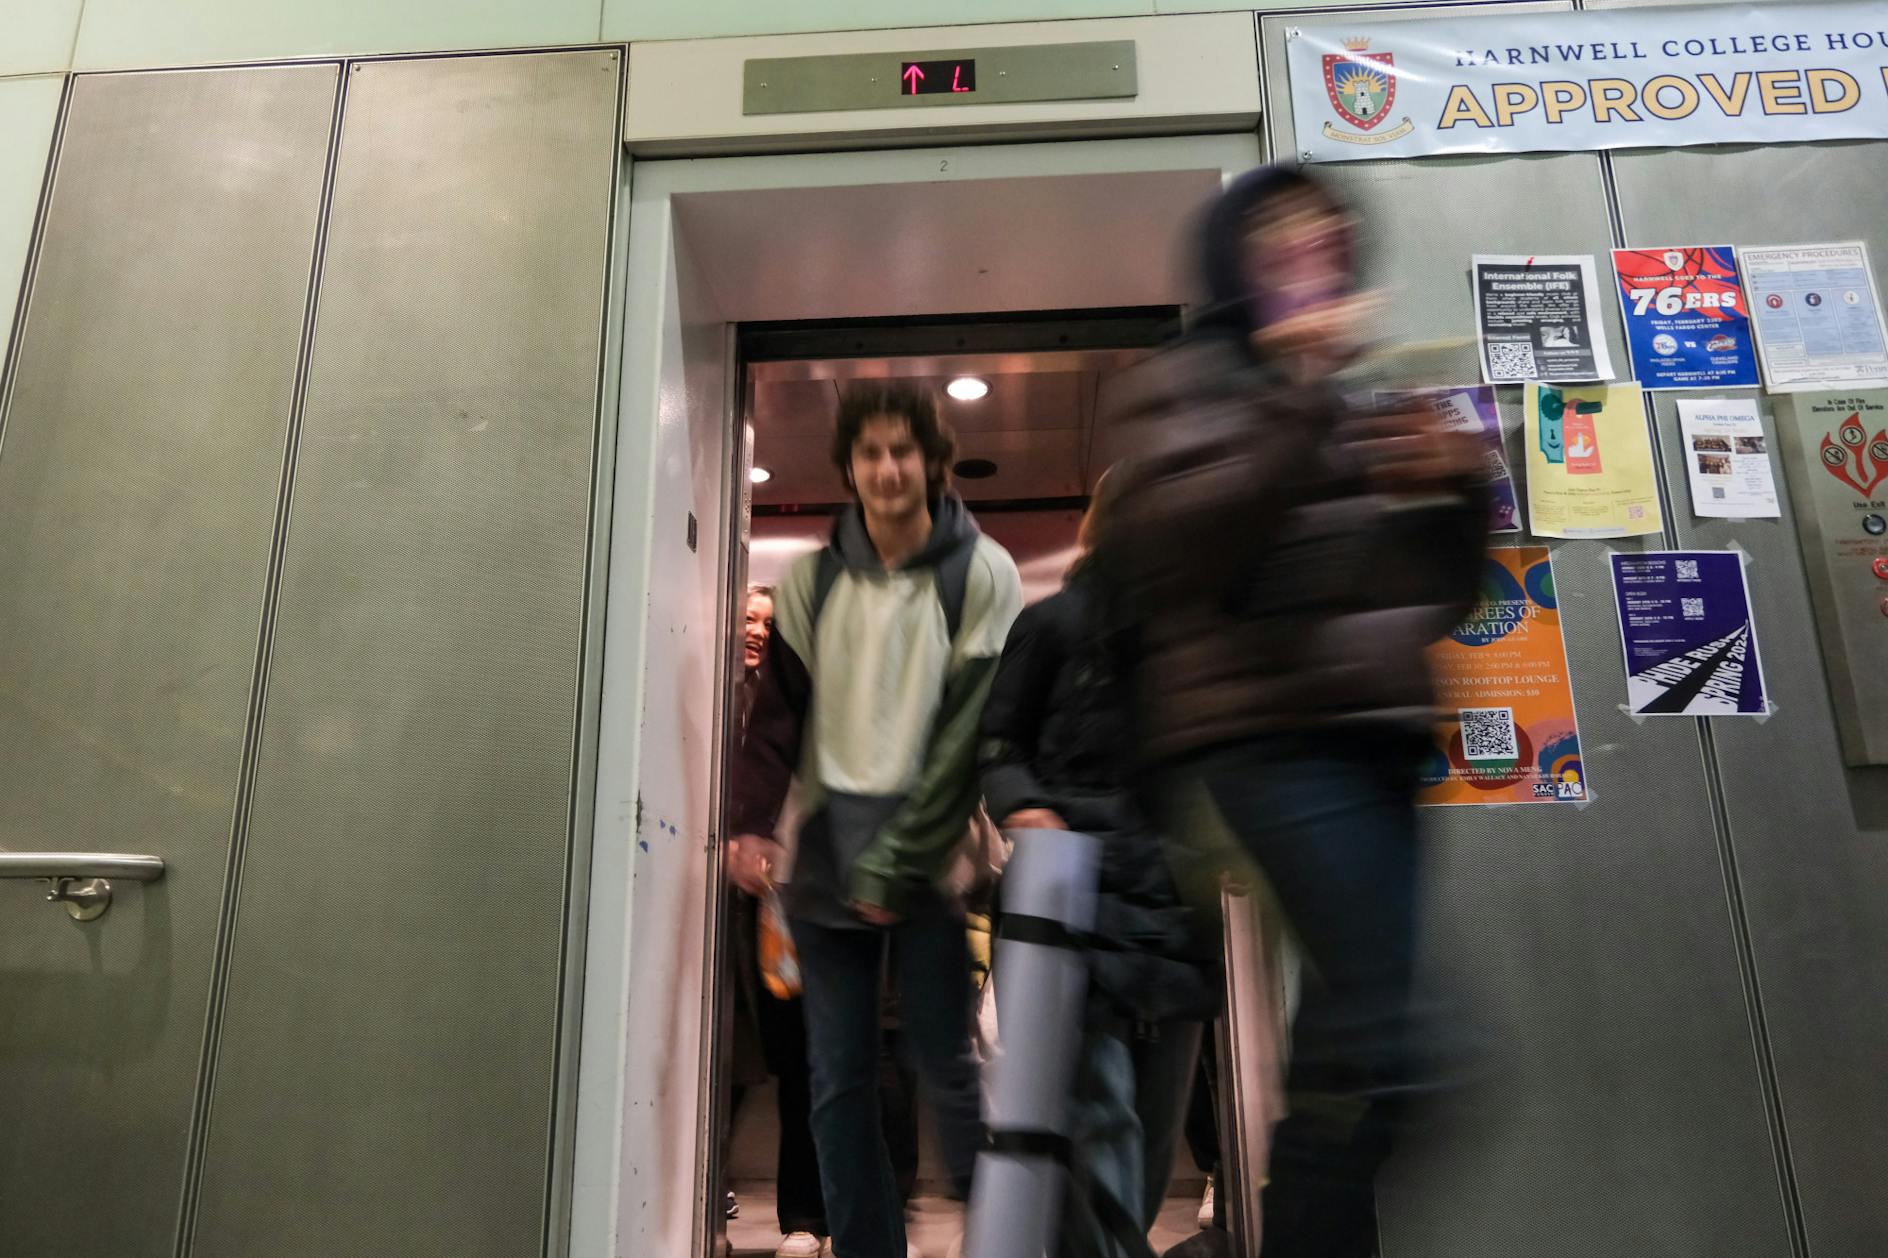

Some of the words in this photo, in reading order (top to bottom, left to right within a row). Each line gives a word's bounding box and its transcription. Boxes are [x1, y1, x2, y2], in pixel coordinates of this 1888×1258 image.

[1455, 42, 1647, 67] HARNWELL
[1661, 34, 1811, 57] COLLEGE
[1437, 68, 1861, 130] APPROVED
[939, 159, 949, 172] 2
[1747, 252, 1800, 261] EMERGENCY
[1802, 248, 1859, 258] PROCEDURES
[1483, 272, 1551, 281] International
[1552, 272, 1578, 280] Folk
[1491, 282, 1544, 291] Ensemble
[1545, 282, 1571, 291] (IFE)
[1629, 286, 1737, 316] 76ERS
[1518, 605, 1541, 619] OF
[1452, 621, 1529, 636] ARATION
[1685, 660, 1743, 711] SPRING
[1728, 624, 1748, 662] 2024
[1462, 675, 1513, 686] ROOFTOP
[1514, 673, 1560, 684] LOUNGE
[1448, 767, 1486, 775] DIRECTED
[1498, 766, 1518, 774] NOVA
[1532, 784, 1553, 793] SAC
